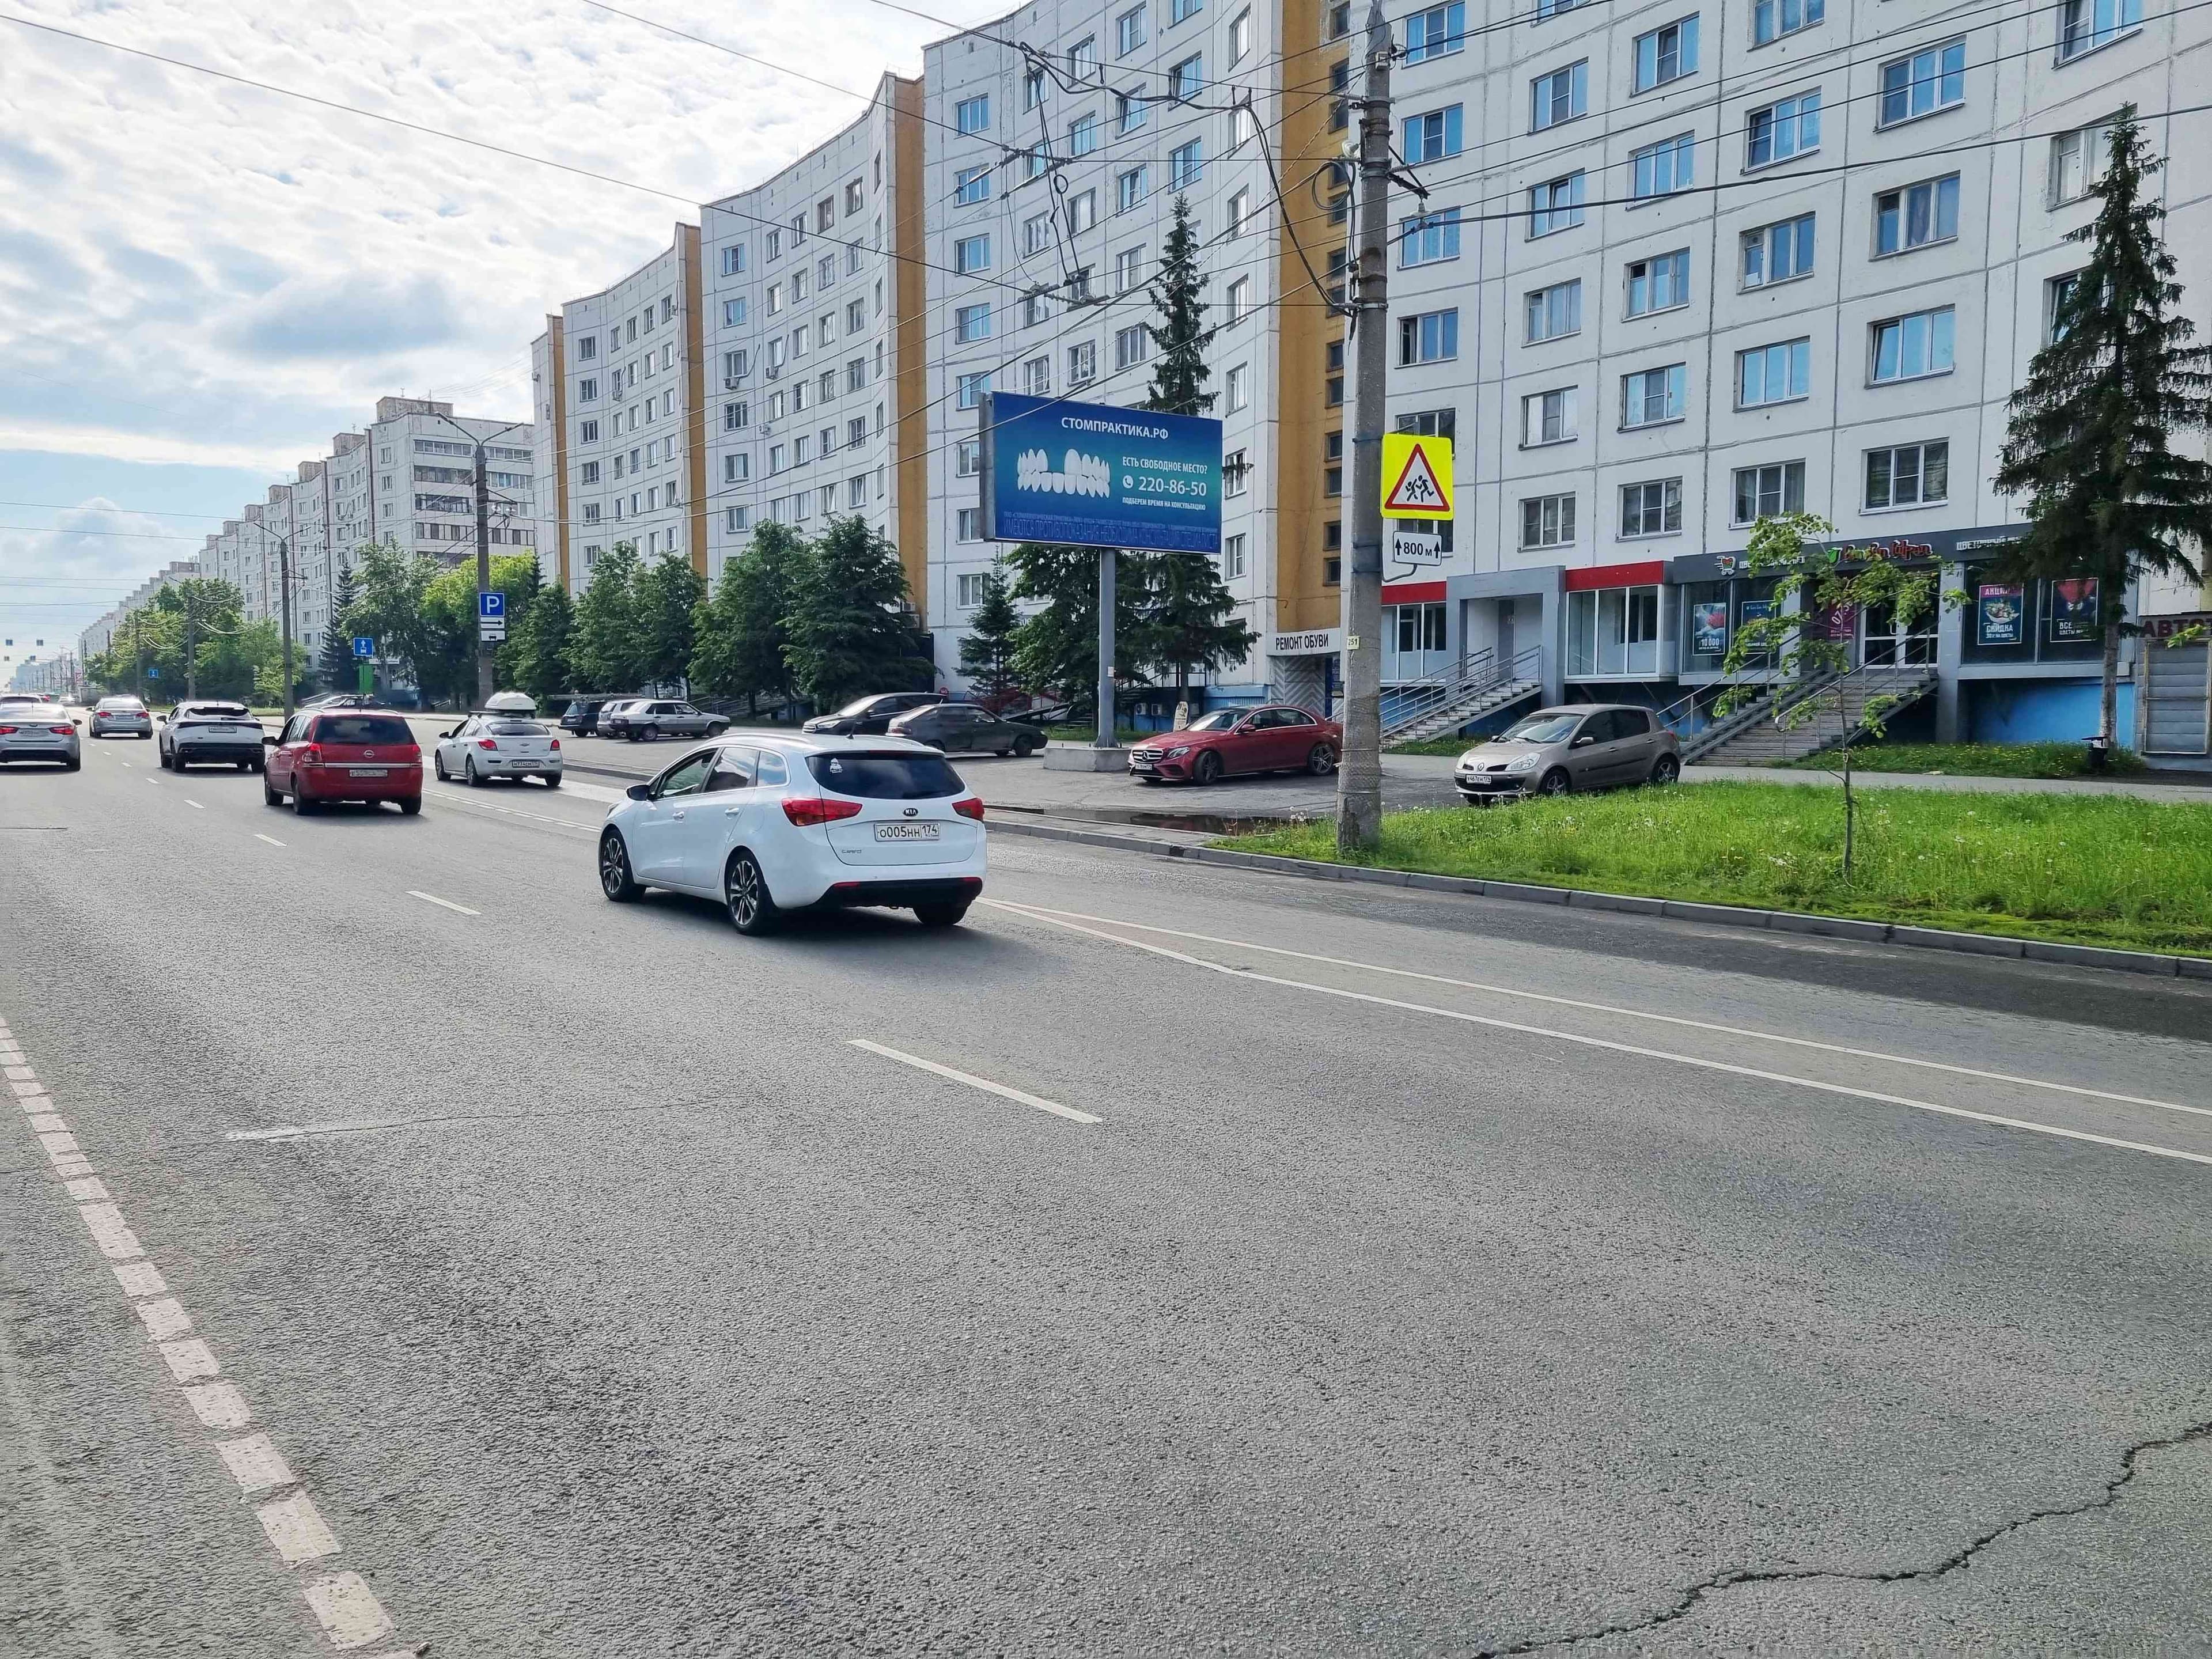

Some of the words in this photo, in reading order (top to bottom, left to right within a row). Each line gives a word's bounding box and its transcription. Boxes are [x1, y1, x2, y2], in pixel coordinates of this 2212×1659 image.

[1061, 417, 1169, 440] СТОМПРАКТИКА.РФ
[1122, 456, 1139, 467] ЕСТЬ
[1140, 459, 1181, 472] СВОБОДНОЕ
[1183, 463, 1207, 474] МЕСТО?
[1138, 476, 1207, 496] 220-86-50
[1122, 497, 1147, 506] ПОДБЕРЕМ
[1147, 499, 1164, 507] ВРЕМЯ
[1171, 502, 1206, 510] КОНСУЛЬТАЦИЮ
[1403, 542, 1423, 555] 800
[486, 595, 500, 613] P
[1986, 624, 2013, 633] СКИДКА
[1275, 635, 1302, 650] РЕМОНТ
[1304, 633, 1329, 648] ОБУВИ
